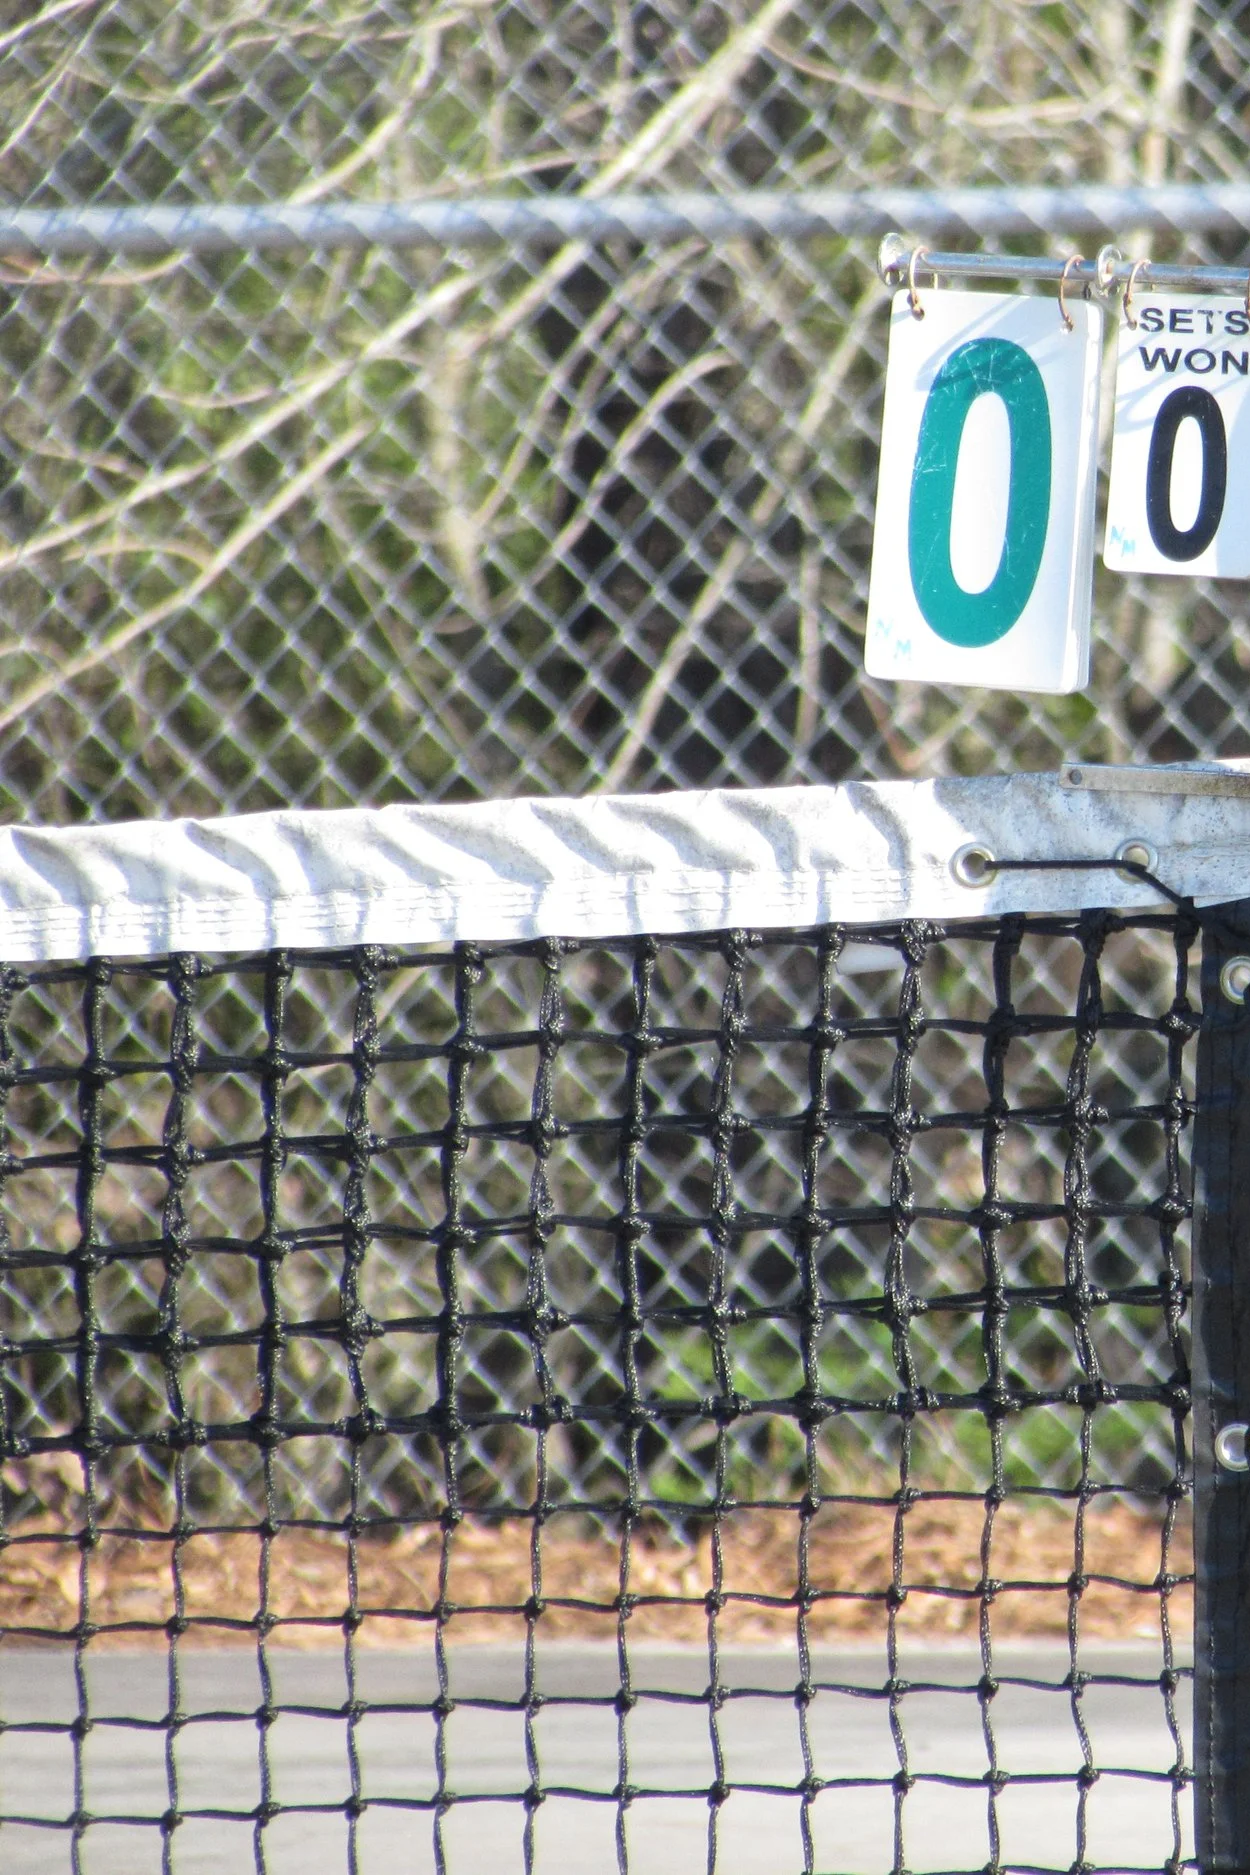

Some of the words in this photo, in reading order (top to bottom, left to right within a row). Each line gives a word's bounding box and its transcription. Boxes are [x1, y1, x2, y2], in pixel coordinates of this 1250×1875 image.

[1138, 346, 1249, 375] WON
[1140, 307, 1250, 336] SETS
[908, 337, 1052, 648] 0
[1146, 385, 1227, 562] 0
